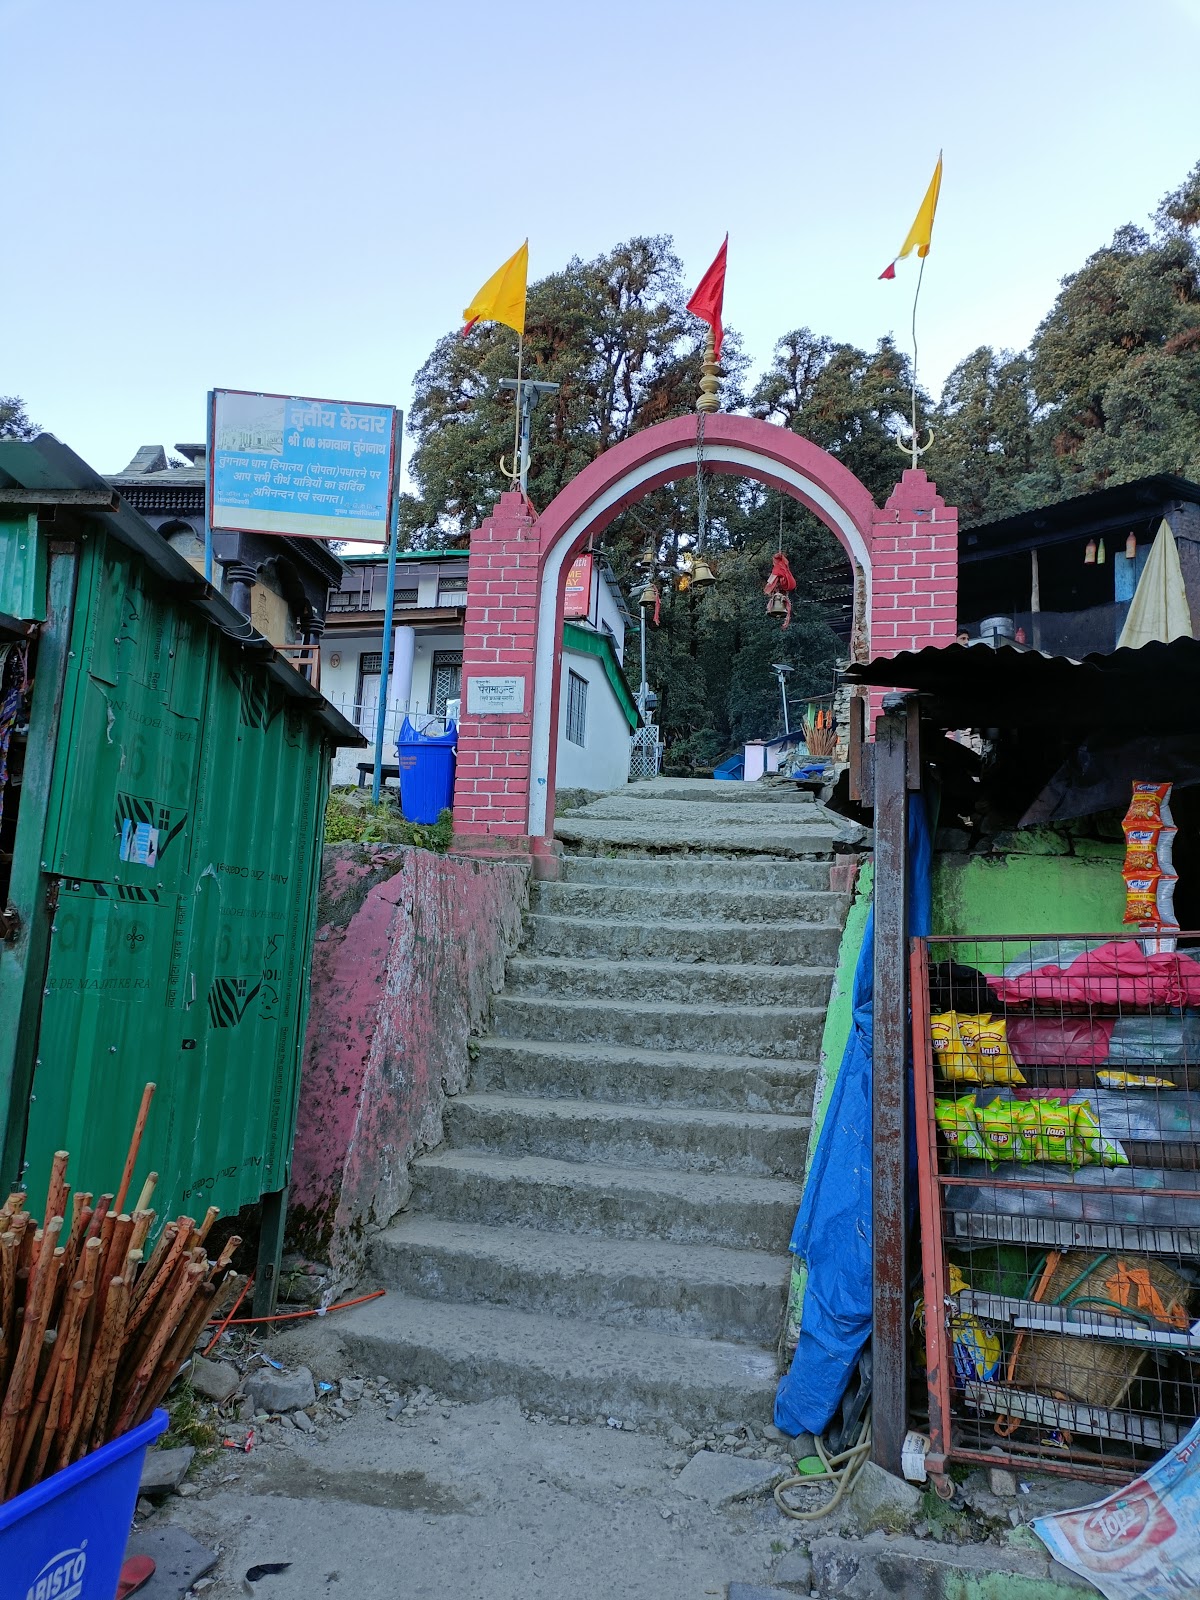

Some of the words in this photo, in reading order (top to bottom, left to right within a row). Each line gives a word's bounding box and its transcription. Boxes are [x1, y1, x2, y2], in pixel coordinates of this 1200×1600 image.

[291, 403, 336, 432] तृतीय
[340, 407, 387, 433] केदार
[288, 432, 300, 447] श्री
[303, 438, 315, 448] 108
[318, 438, 351, 452] भगवान
[353, 438, 386, 457] तुंगनाथ
[219, 454, 249, 468] तुंगनाथ
[252, 459, 268, 469] धाम
[270, 459, 304, 472] हिमालय
[369, 470, 381, 479] पर
[233, 472, 251, 481] आप
[254, 472, 271, 483] सभी
[273, 473, 291, 485] तीर्थ
[293, 475, 322, 488] यात्रियों
[324, 480, 336, 489] का
[338, 478, 366, 492] हार्दिक
[253, 486, 295, 499] अभिनन्दन
[297, 490, 310, 501] एवं
[1090, 1506, 1136, 1542] Tops
